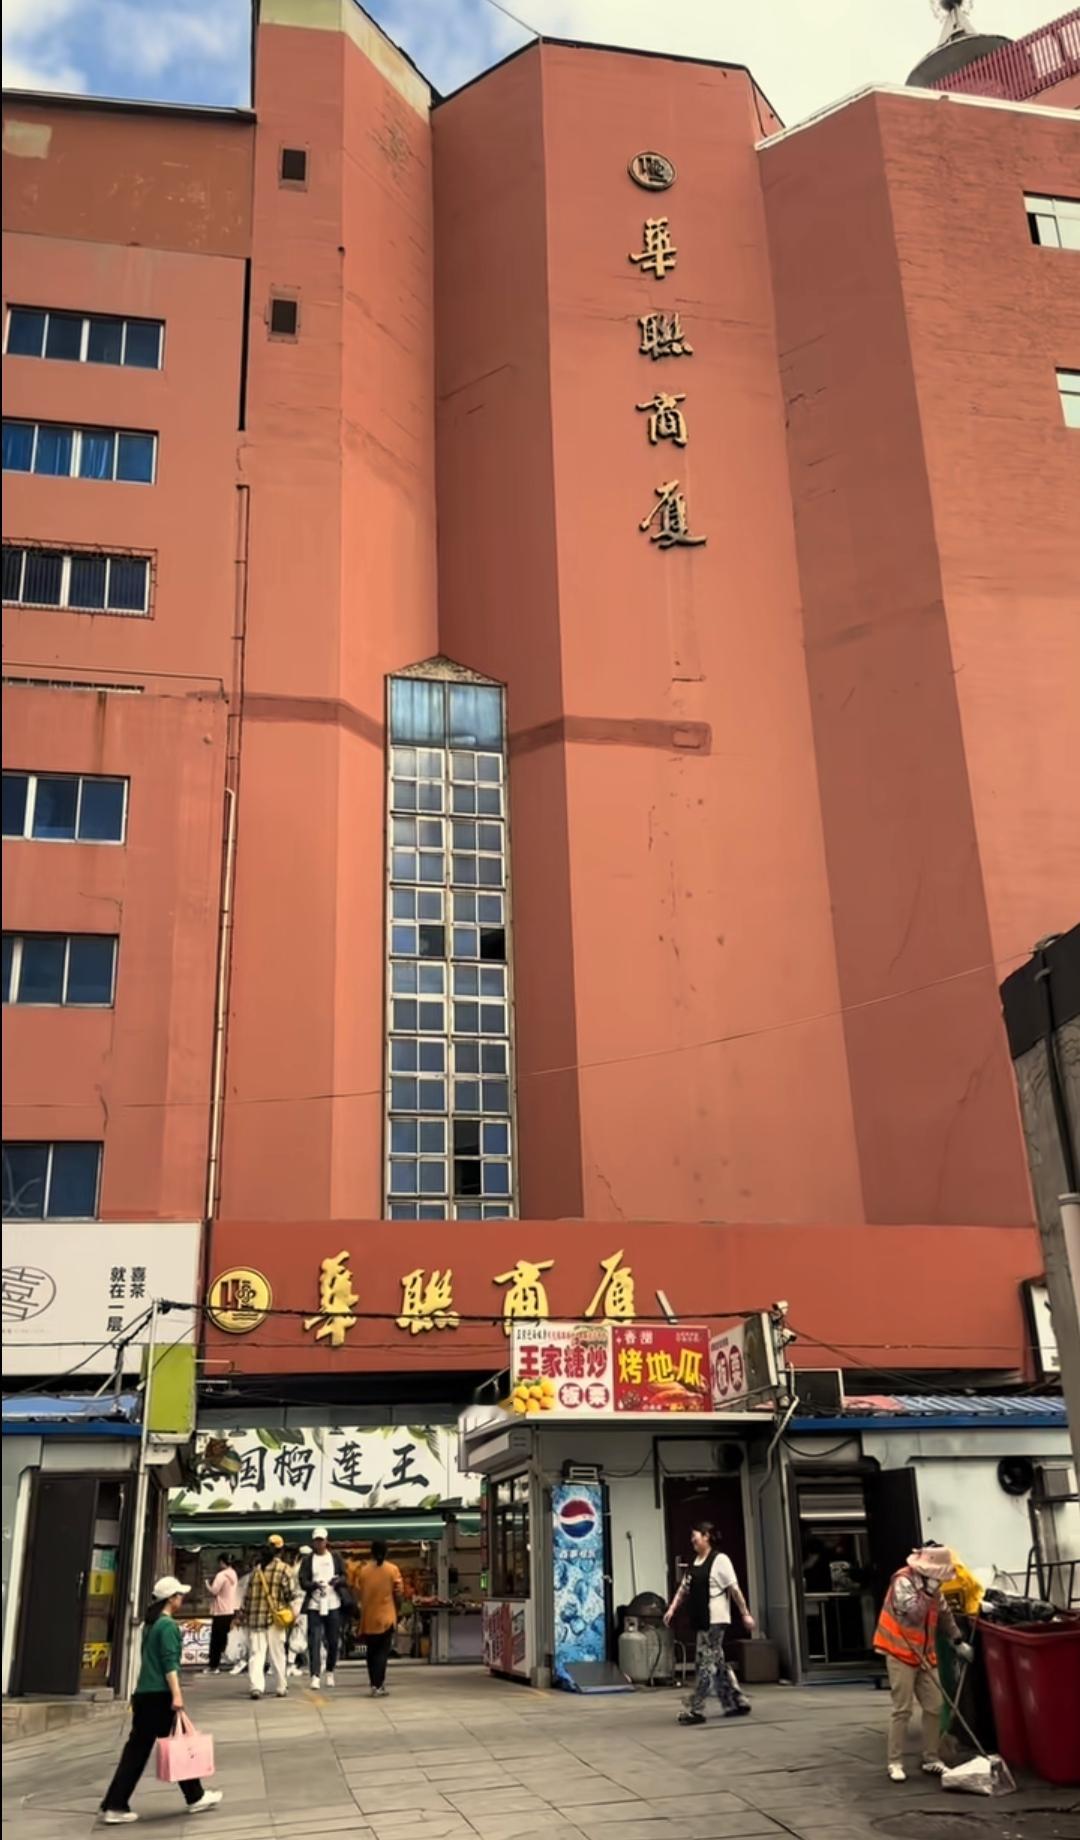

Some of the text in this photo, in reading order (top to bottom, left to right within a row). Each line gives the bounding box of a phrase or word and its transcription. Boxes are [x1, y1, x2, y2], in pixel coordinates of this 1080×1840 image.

[107, 1266, 126, 1332] 就在一层
[130, 1266, 146, 1298] 喜茶
[518, 1343, 607, 1379] 王家糖炒
[618, 1347, 703, 1386] 烤地瓜
